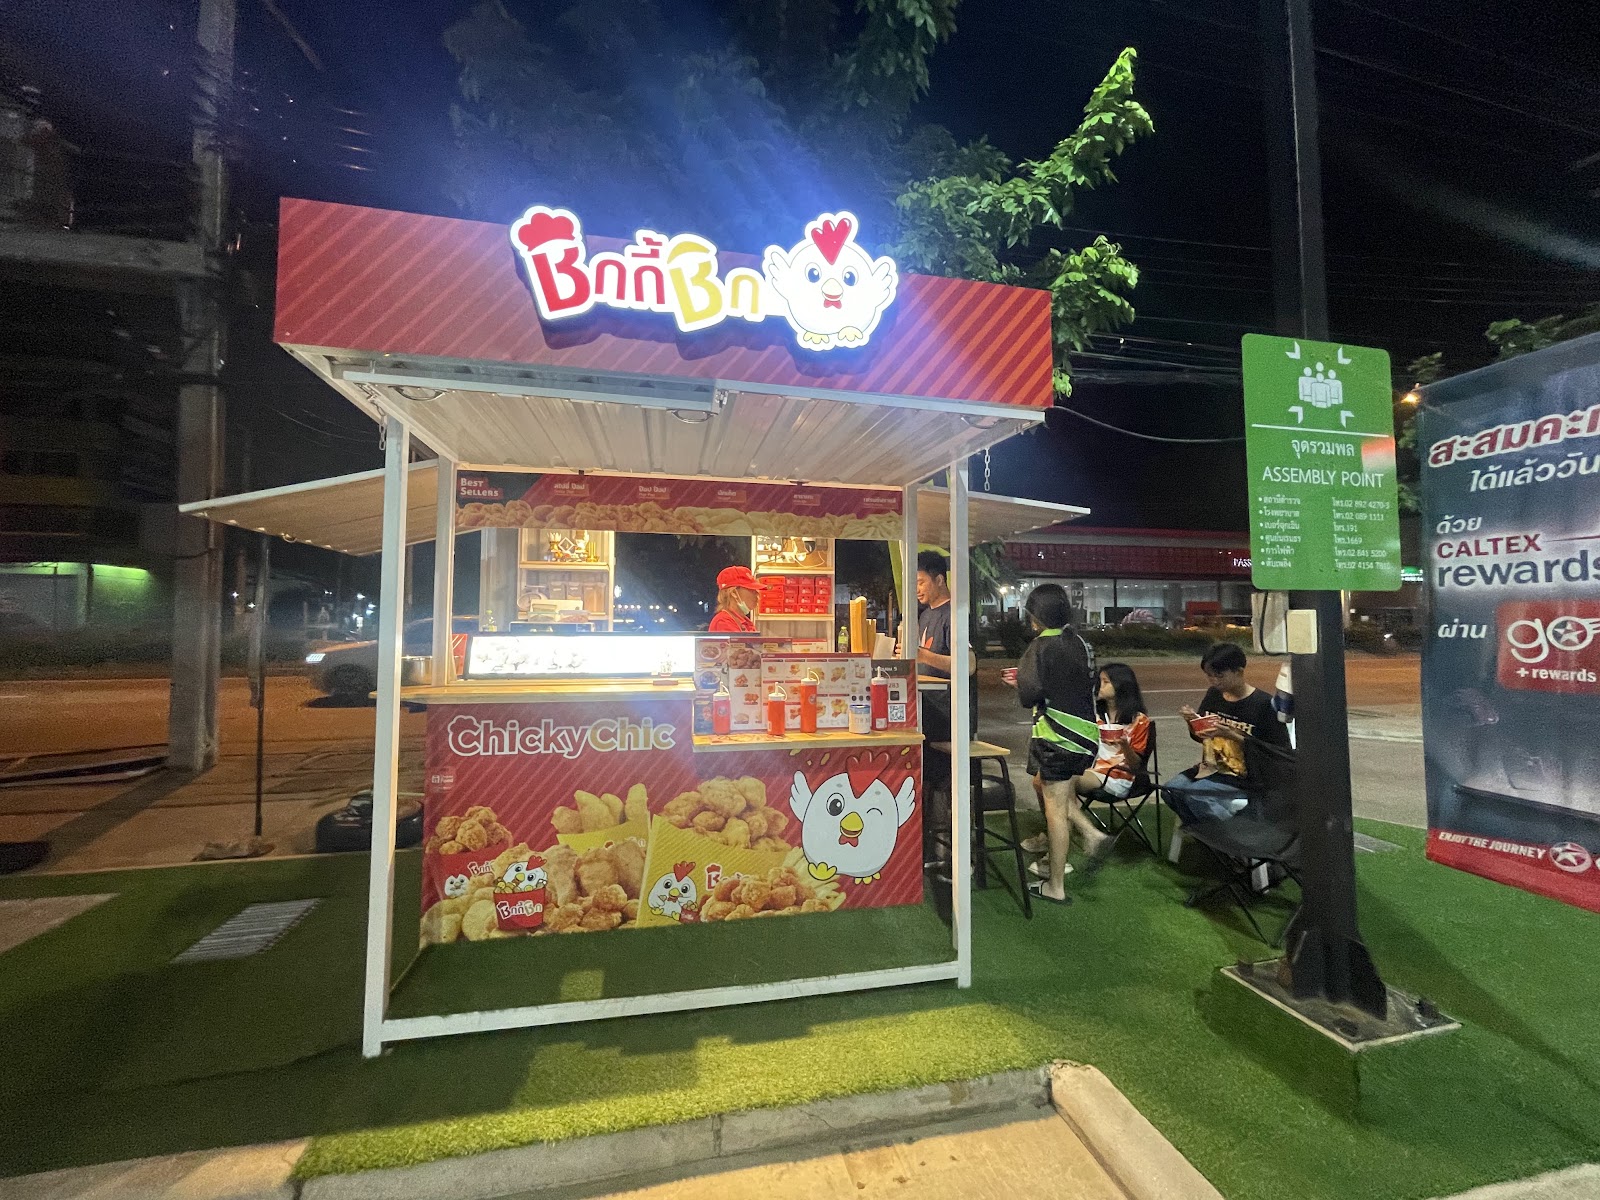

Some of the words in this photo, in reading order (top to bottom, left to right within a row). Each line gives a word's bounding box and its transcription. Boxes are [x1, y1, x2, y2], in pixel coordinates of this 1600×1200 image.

[1291, 439, 1355, 459] จุดรวมพล
[1262, 466, 1337, 486] ASSEMBLY
[1341, 471, 1384, 488] POINT
[1436, 515, 1482, 534] ด้วย
[1437, 533, 1542, 559] CALTEX
[1438, 618, 1487, 640] ผ่าน
[1532, 668, 1597, 683] rewards
[1438, 831, 1468, 844] ENJOY
[1468, 836, 1490, 849] THE
[1489, 839, 1547, 860] JOURNEY
